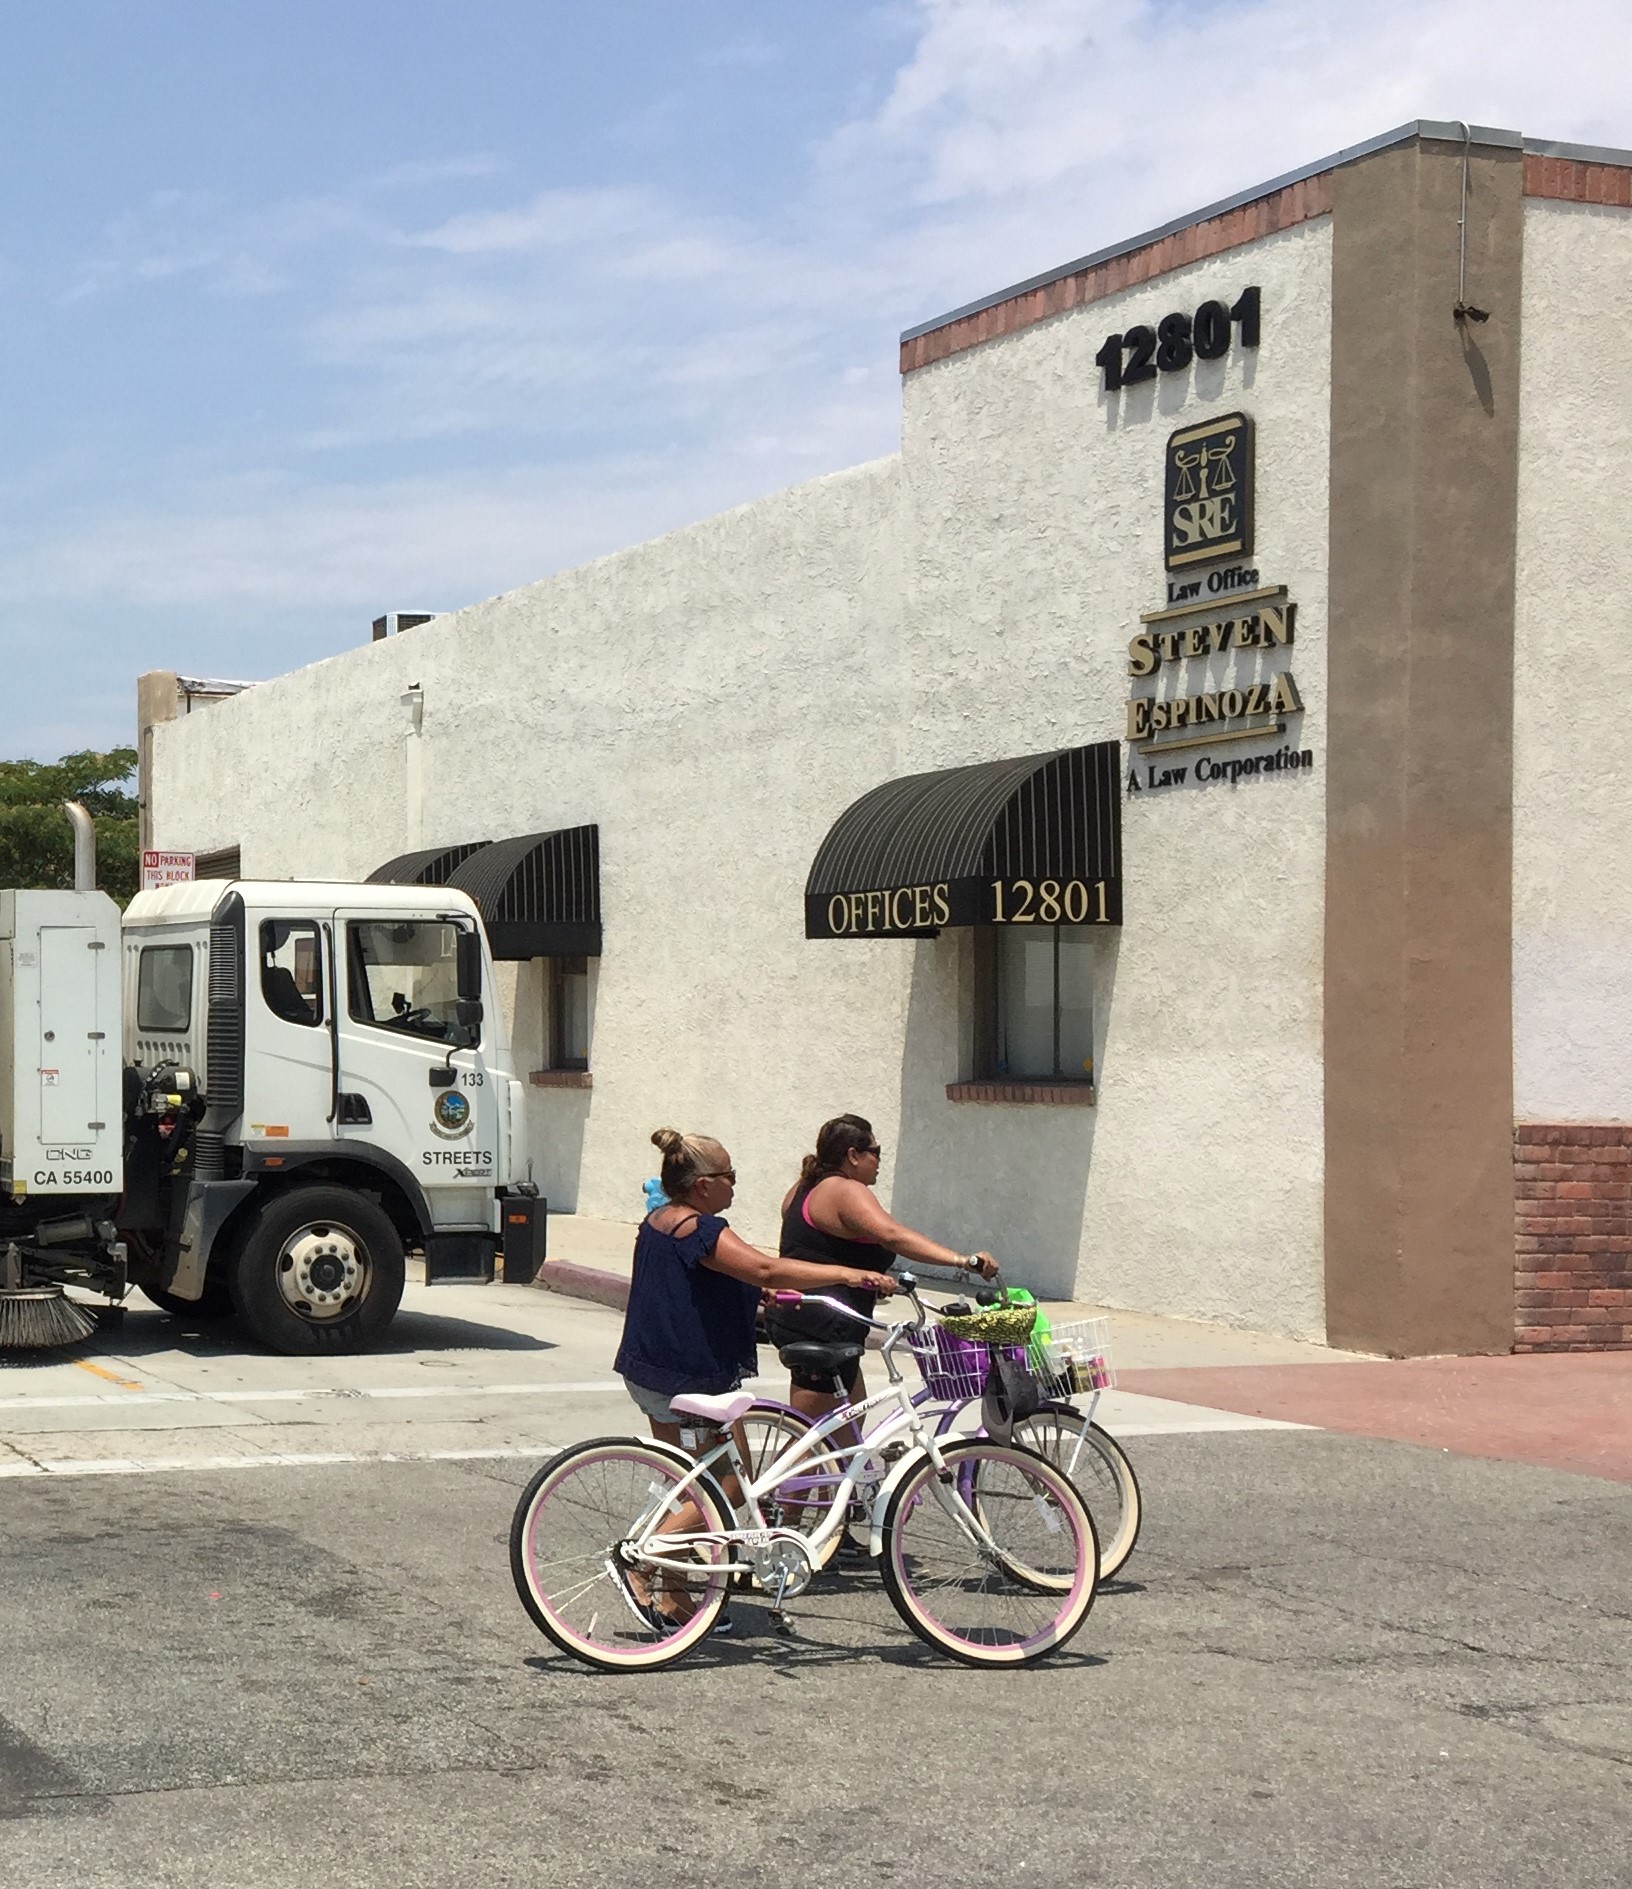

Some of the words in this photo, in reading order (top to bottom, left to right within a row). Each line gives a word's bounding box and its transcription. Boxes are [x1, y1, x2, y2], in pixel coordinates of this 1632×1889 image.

[1096, 286, 1261, 391] 12801
[1172, 492, 1238, 548] SRE
[1168, 578, 1202, 603] Law
[1207, 565, 1260, 594] Office
[1127, 603, 1296, 677] STEVEN
[1125, 672, 1304, 741] ESPINOZA
[1126, 769, 1142, 792] A
[1148, 765, 1188, 789] Law
[1195, 745, 1314, 784] Corporation
[145, 853, 158, 866] NO
[160, 855, 192, 867] PARKING
[147, 870, 163, 880] THIS
[166, 870, 190, 881] BLOCK
[827, 882, 951, 934] OFFICES
[990, 879, 1111, 924] 12801
[462, 1073, 484, 1086] 133
[46, 1148, 93, 1161] CNG
[422, 1151, 493, 1165] STREETS
[33, 1171, 58, 1186] CA
[62, 1170, 113, 1185] 55400
